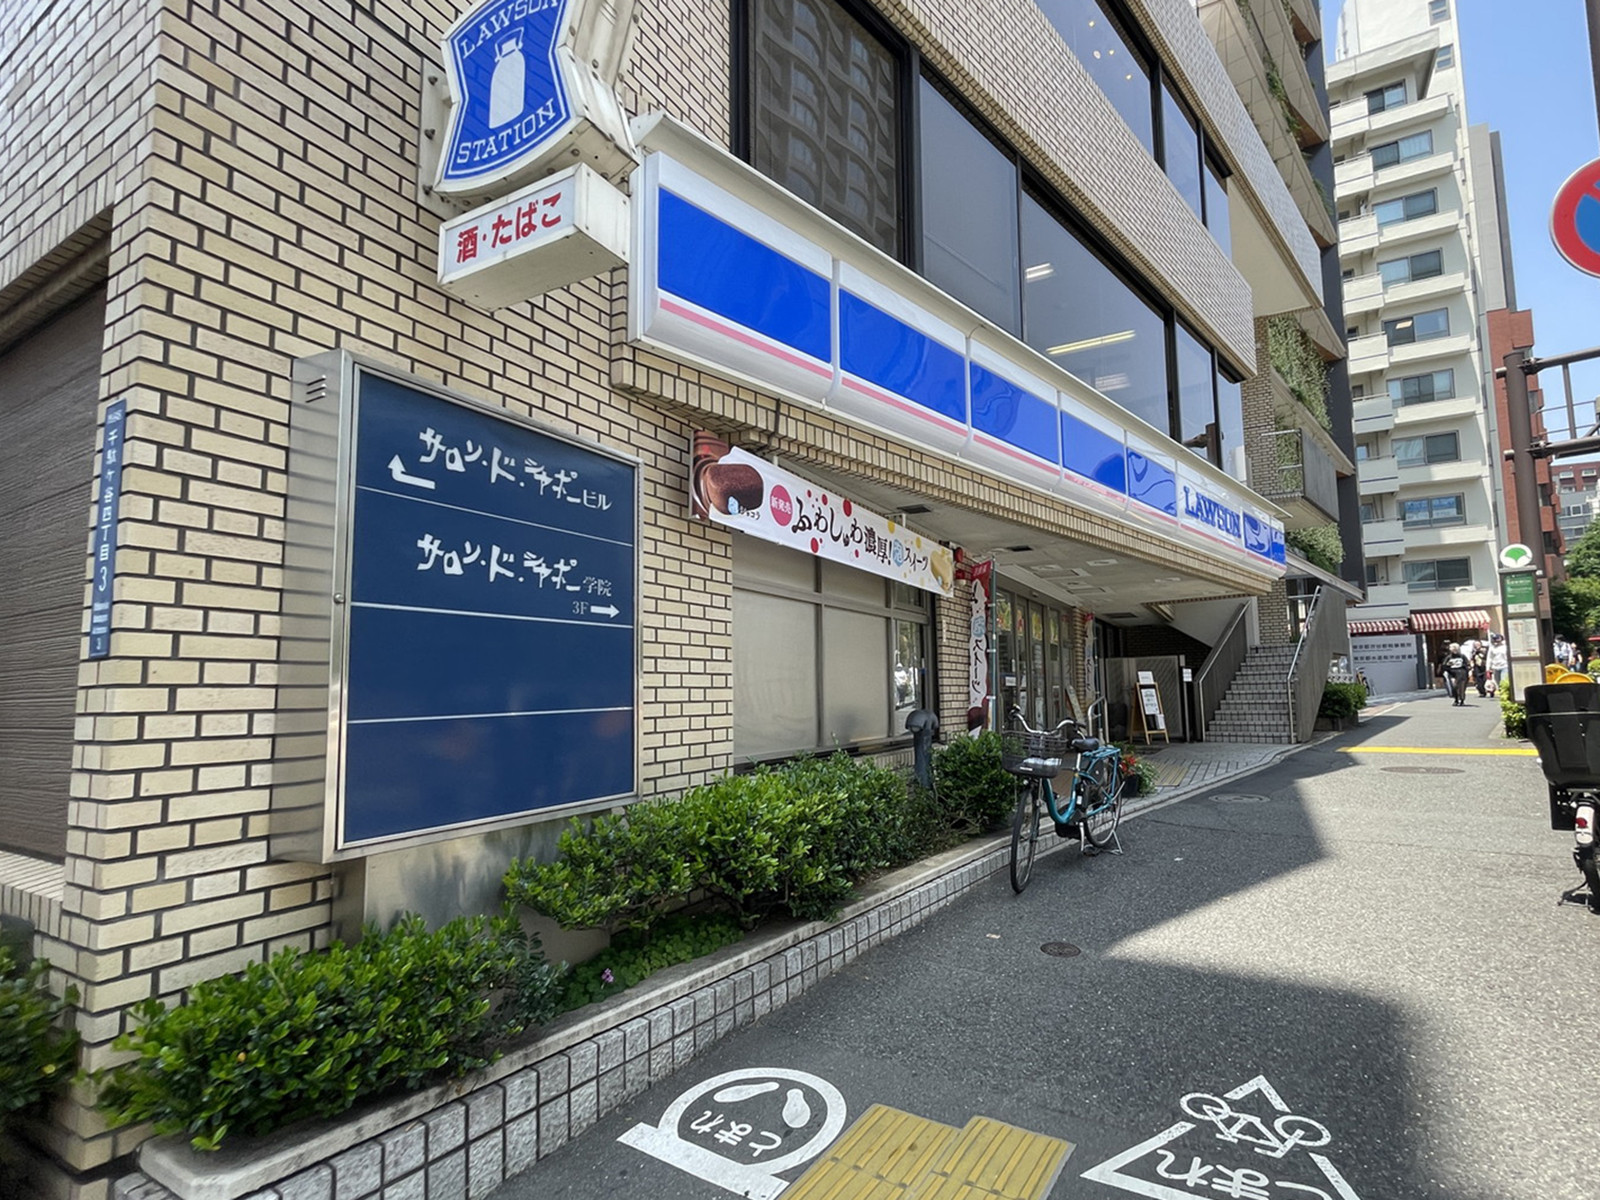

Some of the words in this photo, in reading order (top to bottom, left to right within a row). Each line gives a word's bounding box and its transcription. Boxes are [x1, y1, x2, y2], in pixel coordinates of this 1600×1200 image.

[456, 98, 555, 164] STATION
[456, 192, 562, 264] 酒・たばこ
[1183, 485, 1242, 539] LAWSON
[572, 601, 589, 615] 3F
[690, 1110, 782, 1158] とまれ
